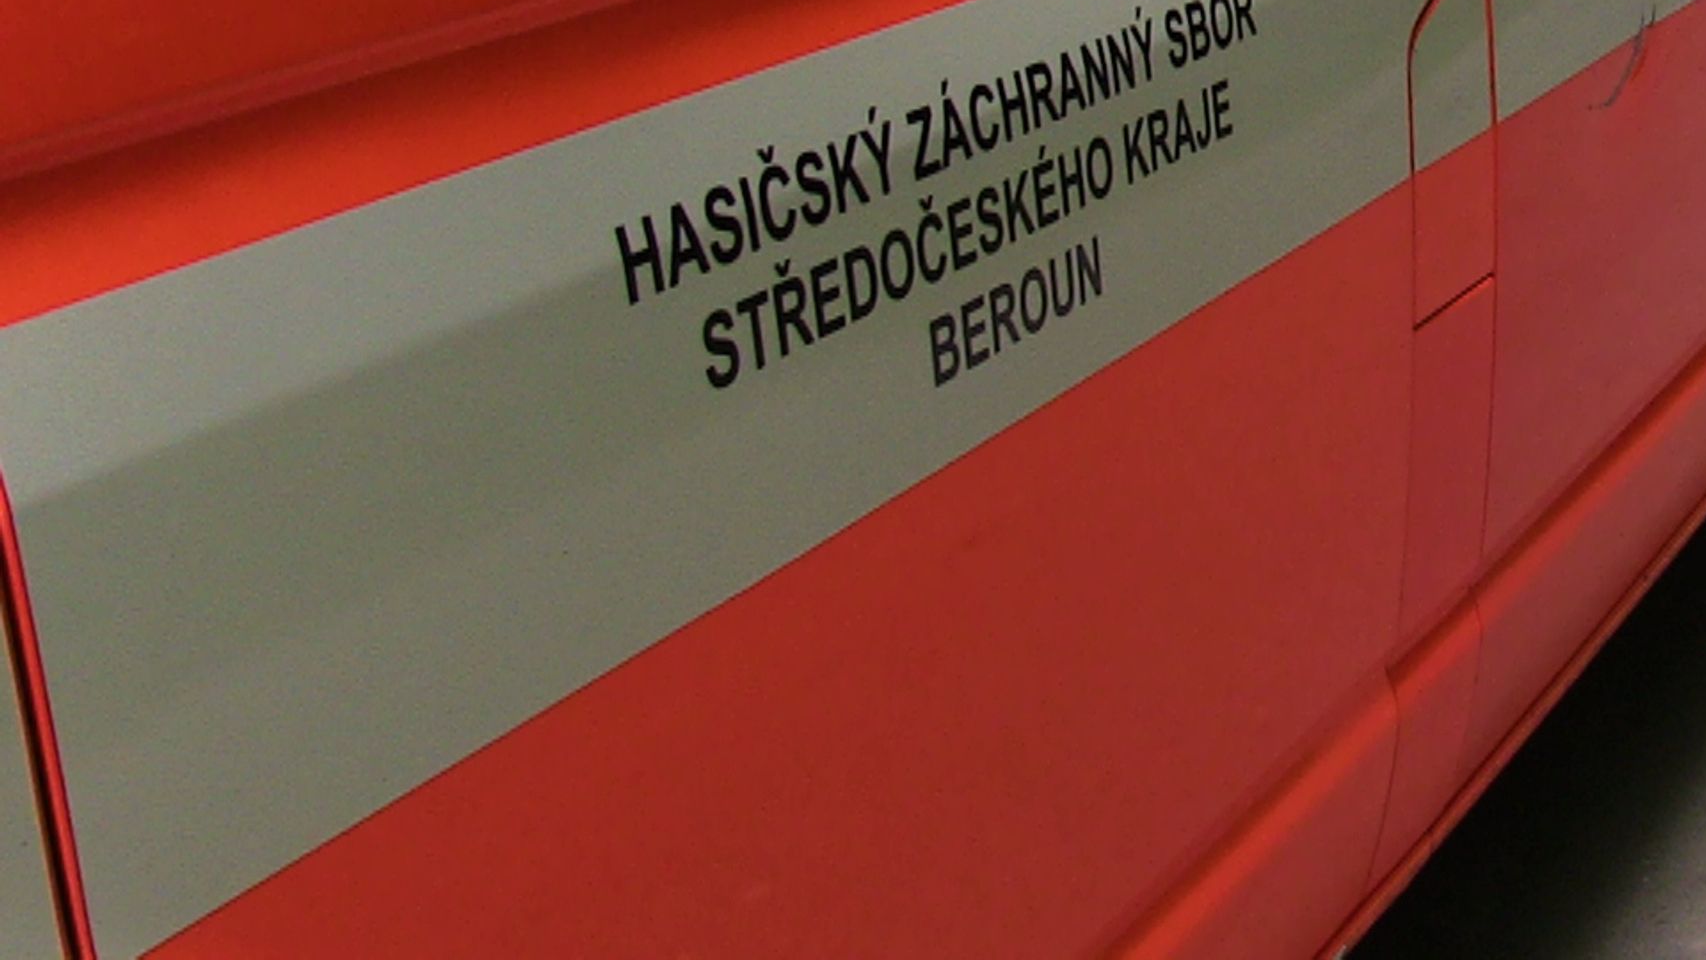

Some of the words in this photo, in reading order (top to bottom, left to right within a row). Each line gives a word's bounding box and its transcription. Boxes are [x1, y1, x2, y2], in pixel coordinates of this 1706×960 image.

[614, 107, 892, 305] HASIČSKÝ
[905, 6, 1154, 180] ZÁCHRANNÝ
[702, 136, 1114, 389] STŘEDOČESKÉHO
[1122, 79, 1234, 185] KRAJE
[928, 237, 1104, 388] BEROUN
